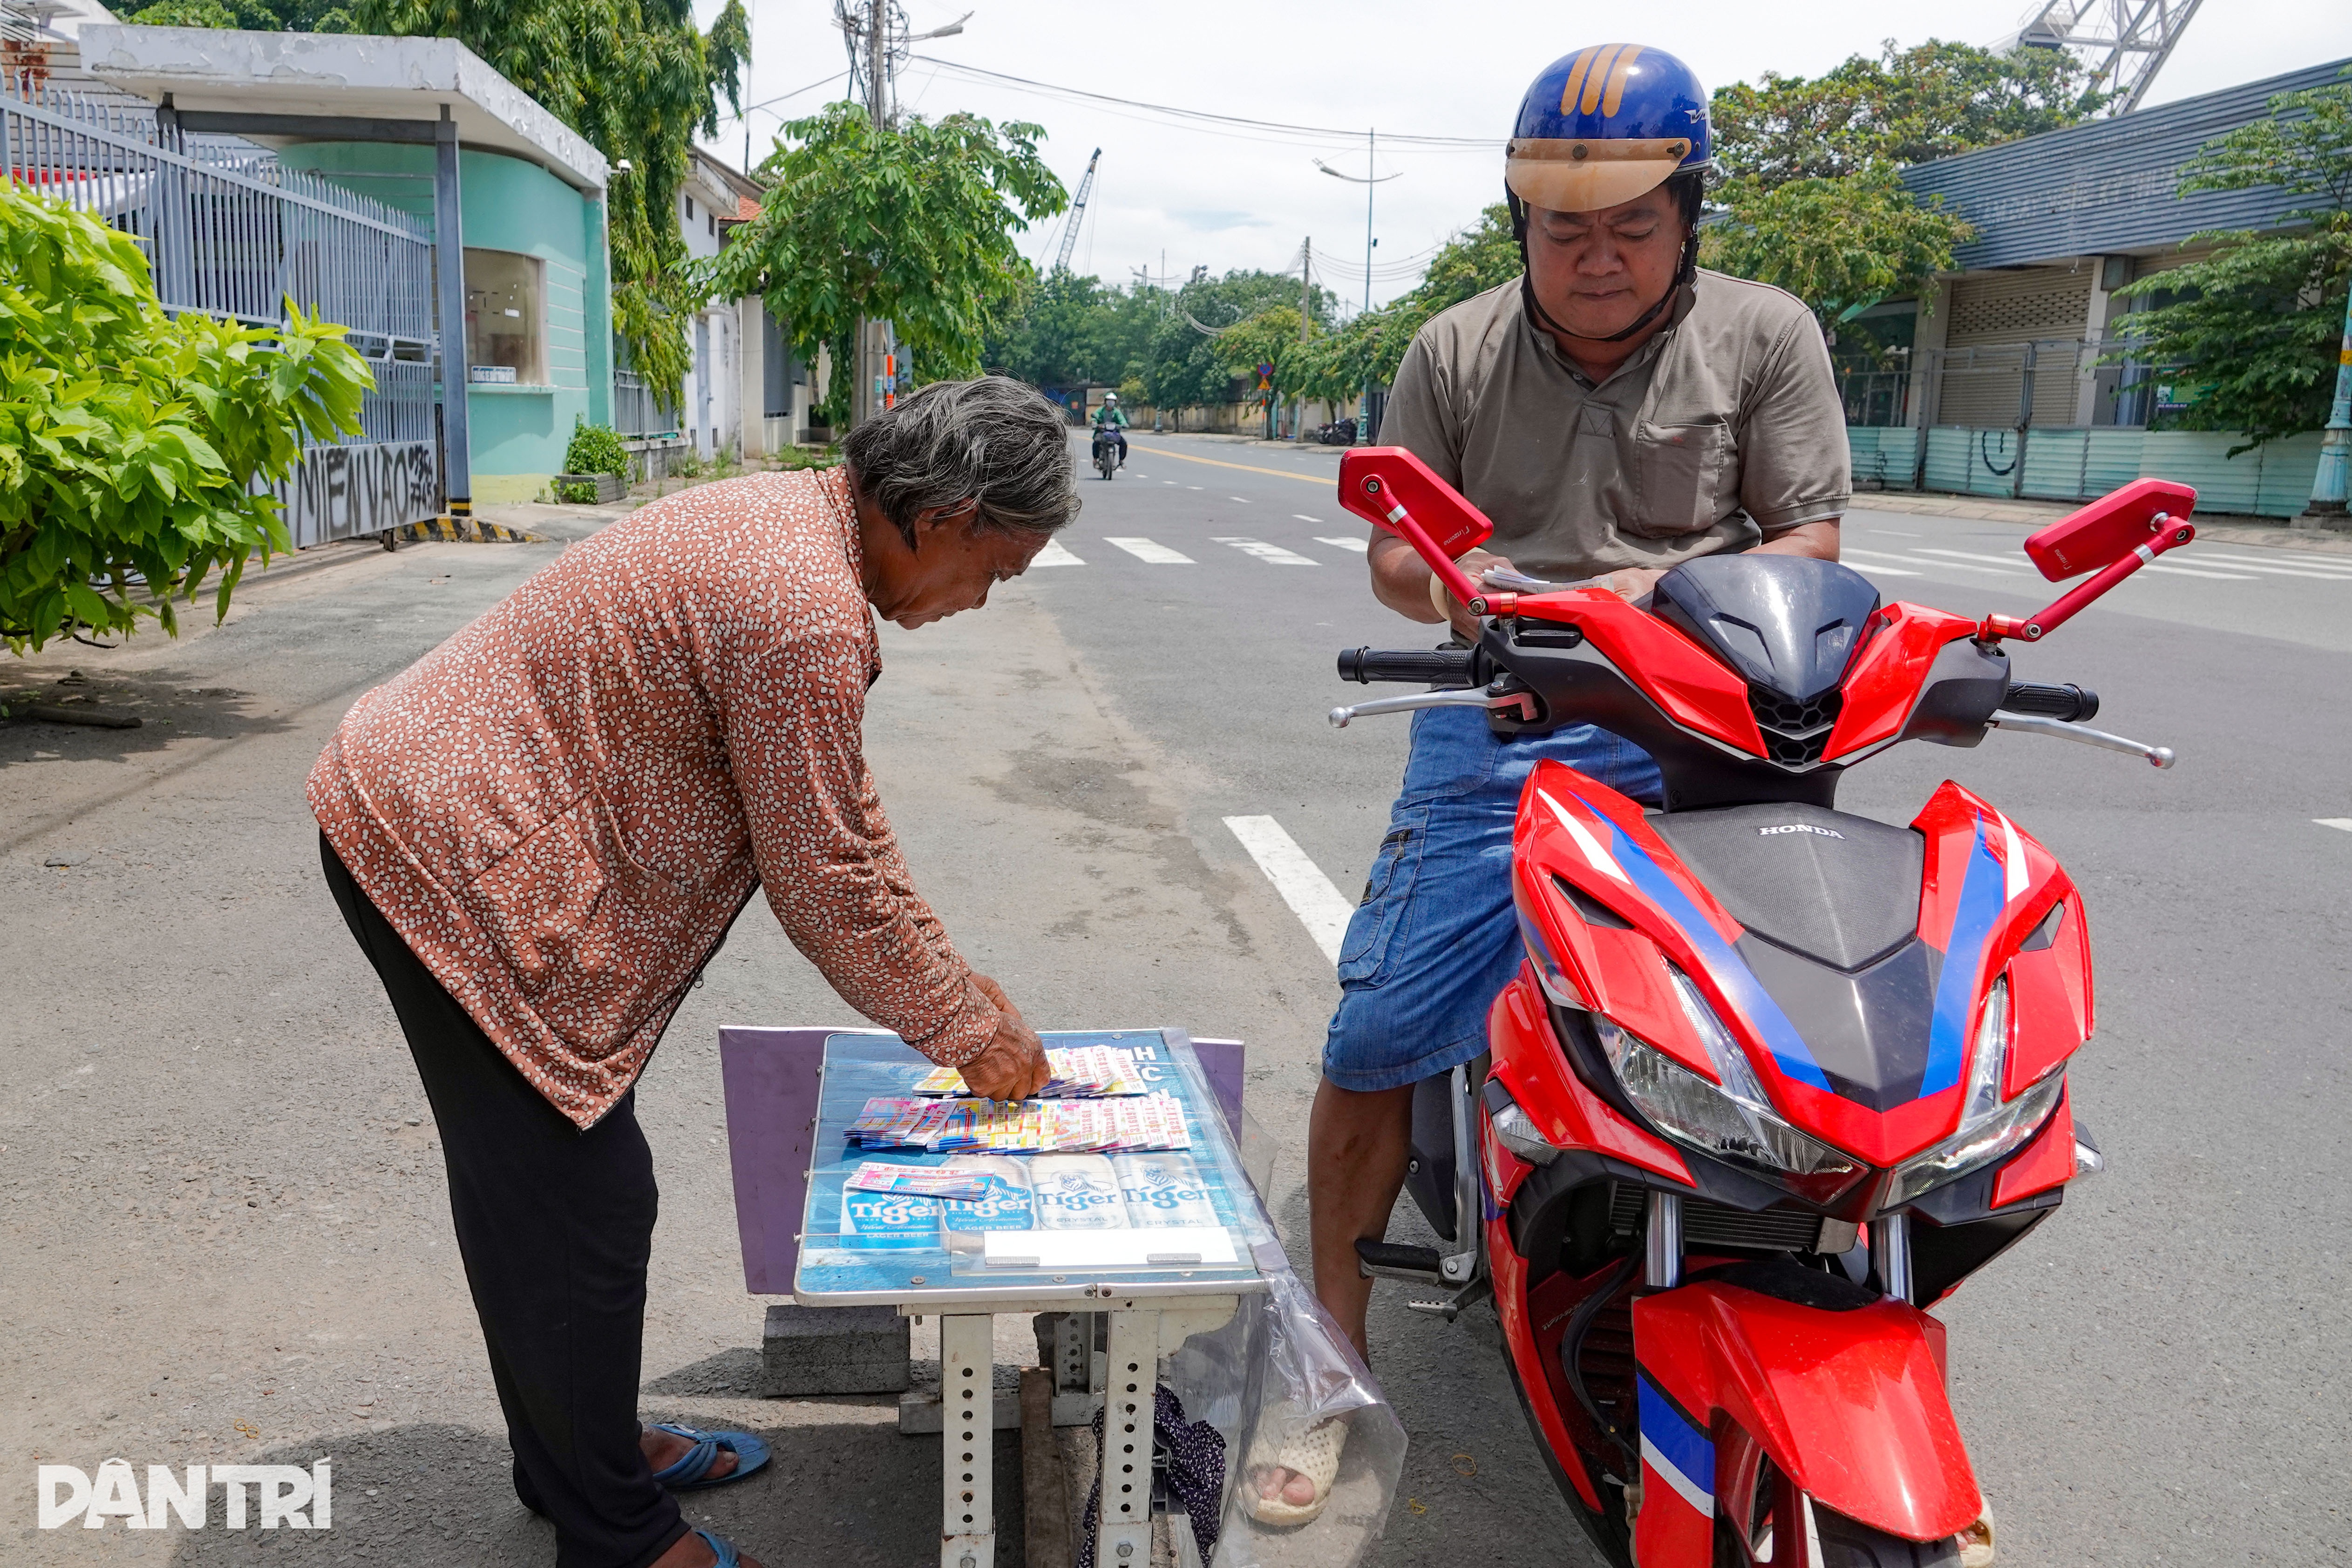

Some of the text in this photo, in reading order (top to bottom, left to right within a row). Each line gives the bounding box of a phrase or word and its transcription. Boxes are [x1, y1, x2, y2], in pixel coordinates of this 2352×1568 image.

[1759, 824, 1846, 840] HONDA
[945, 1195, 1030, 1217] Tiger
[1037, 1191, 1116, 1211] Tiger
[1122, 1185, 1205, 1209] Tiger
[850, 1201, 938, 1224] Tiger
